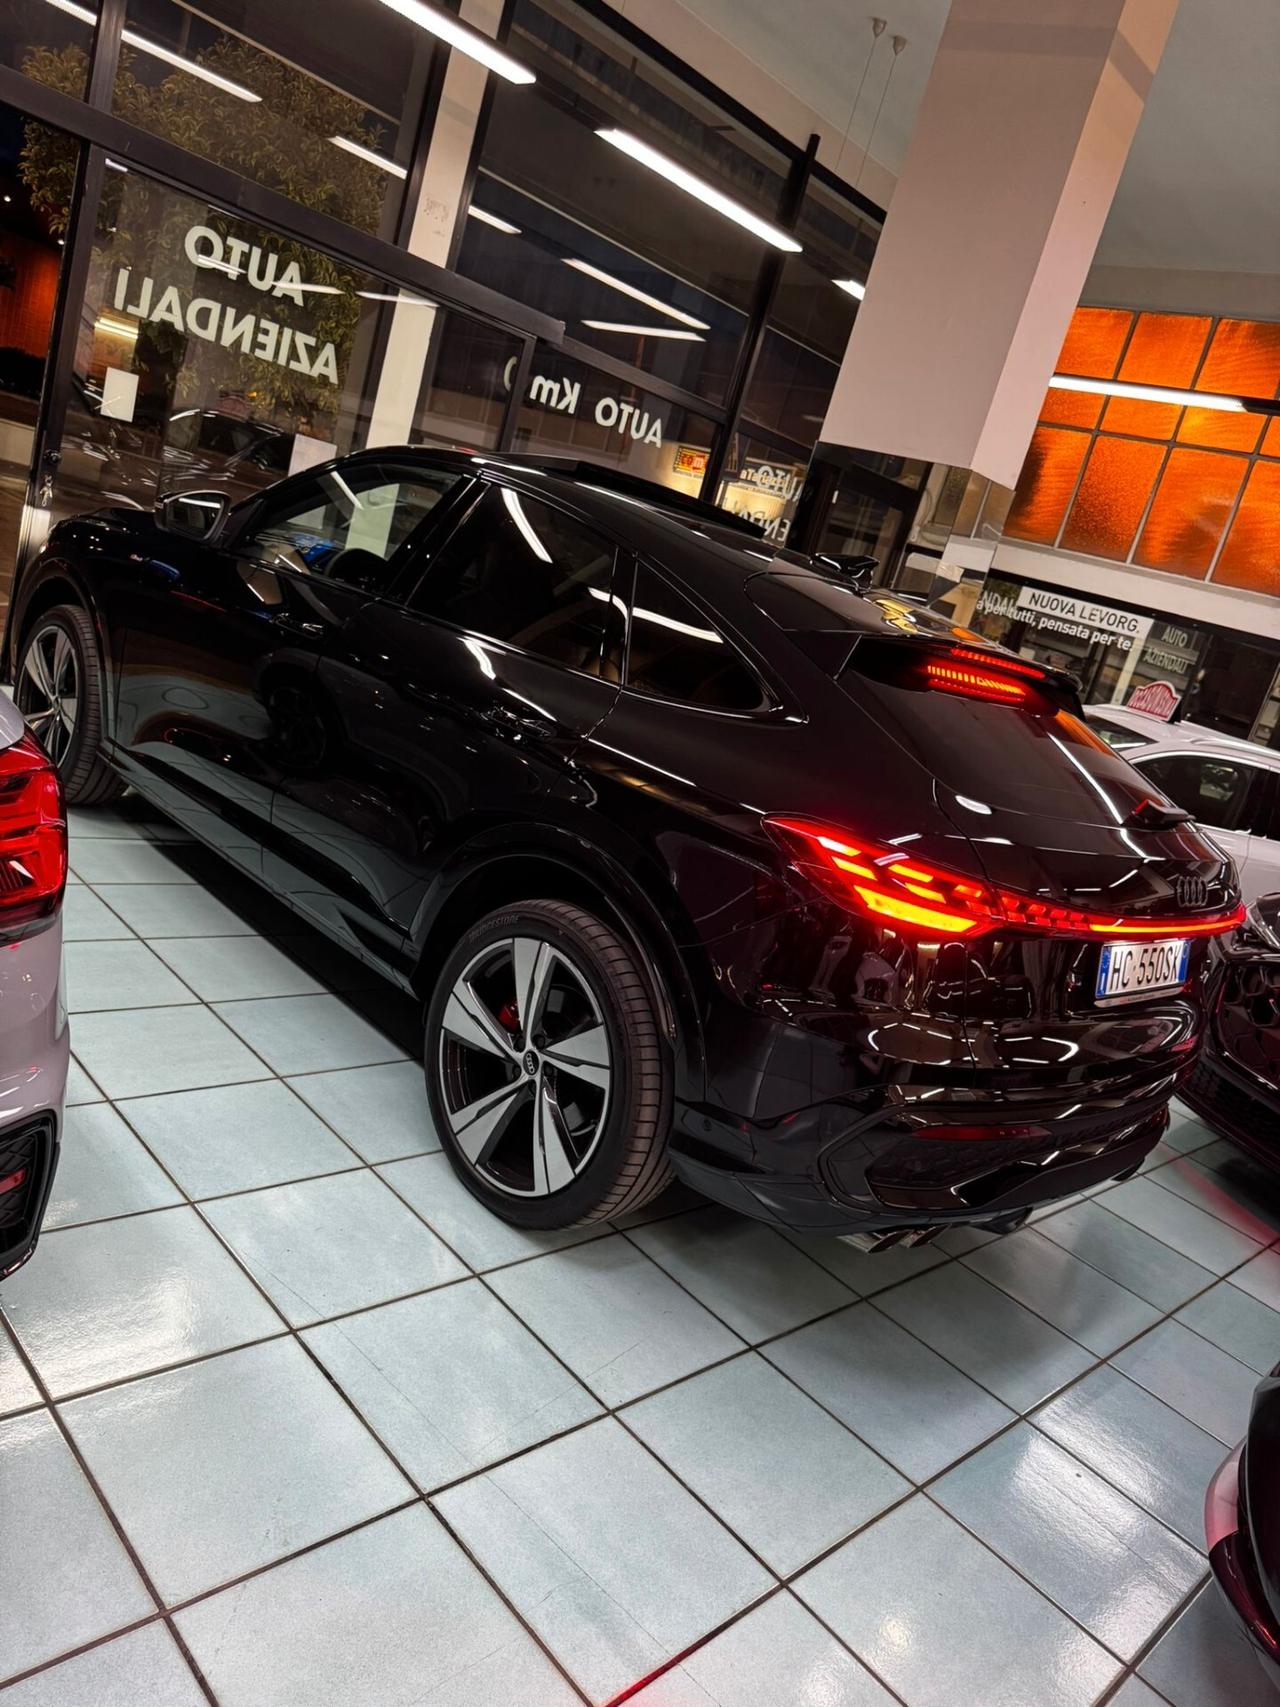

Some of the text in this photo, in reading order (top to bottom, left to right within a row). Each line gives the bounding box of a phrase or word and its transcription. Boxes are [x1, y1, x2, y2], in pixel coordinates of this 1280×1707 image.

[1007, 604, 1037, 627] tutti,
[1037, 616, 1089, 639] pensata
[1090, 631, 1117, 647] per
[1028, 591, 1140, 634] NUOVA LEVORG.
[1161, 626, 1188, 647] AUTO
[1109, 945, 1180, 990] HC 550SK
